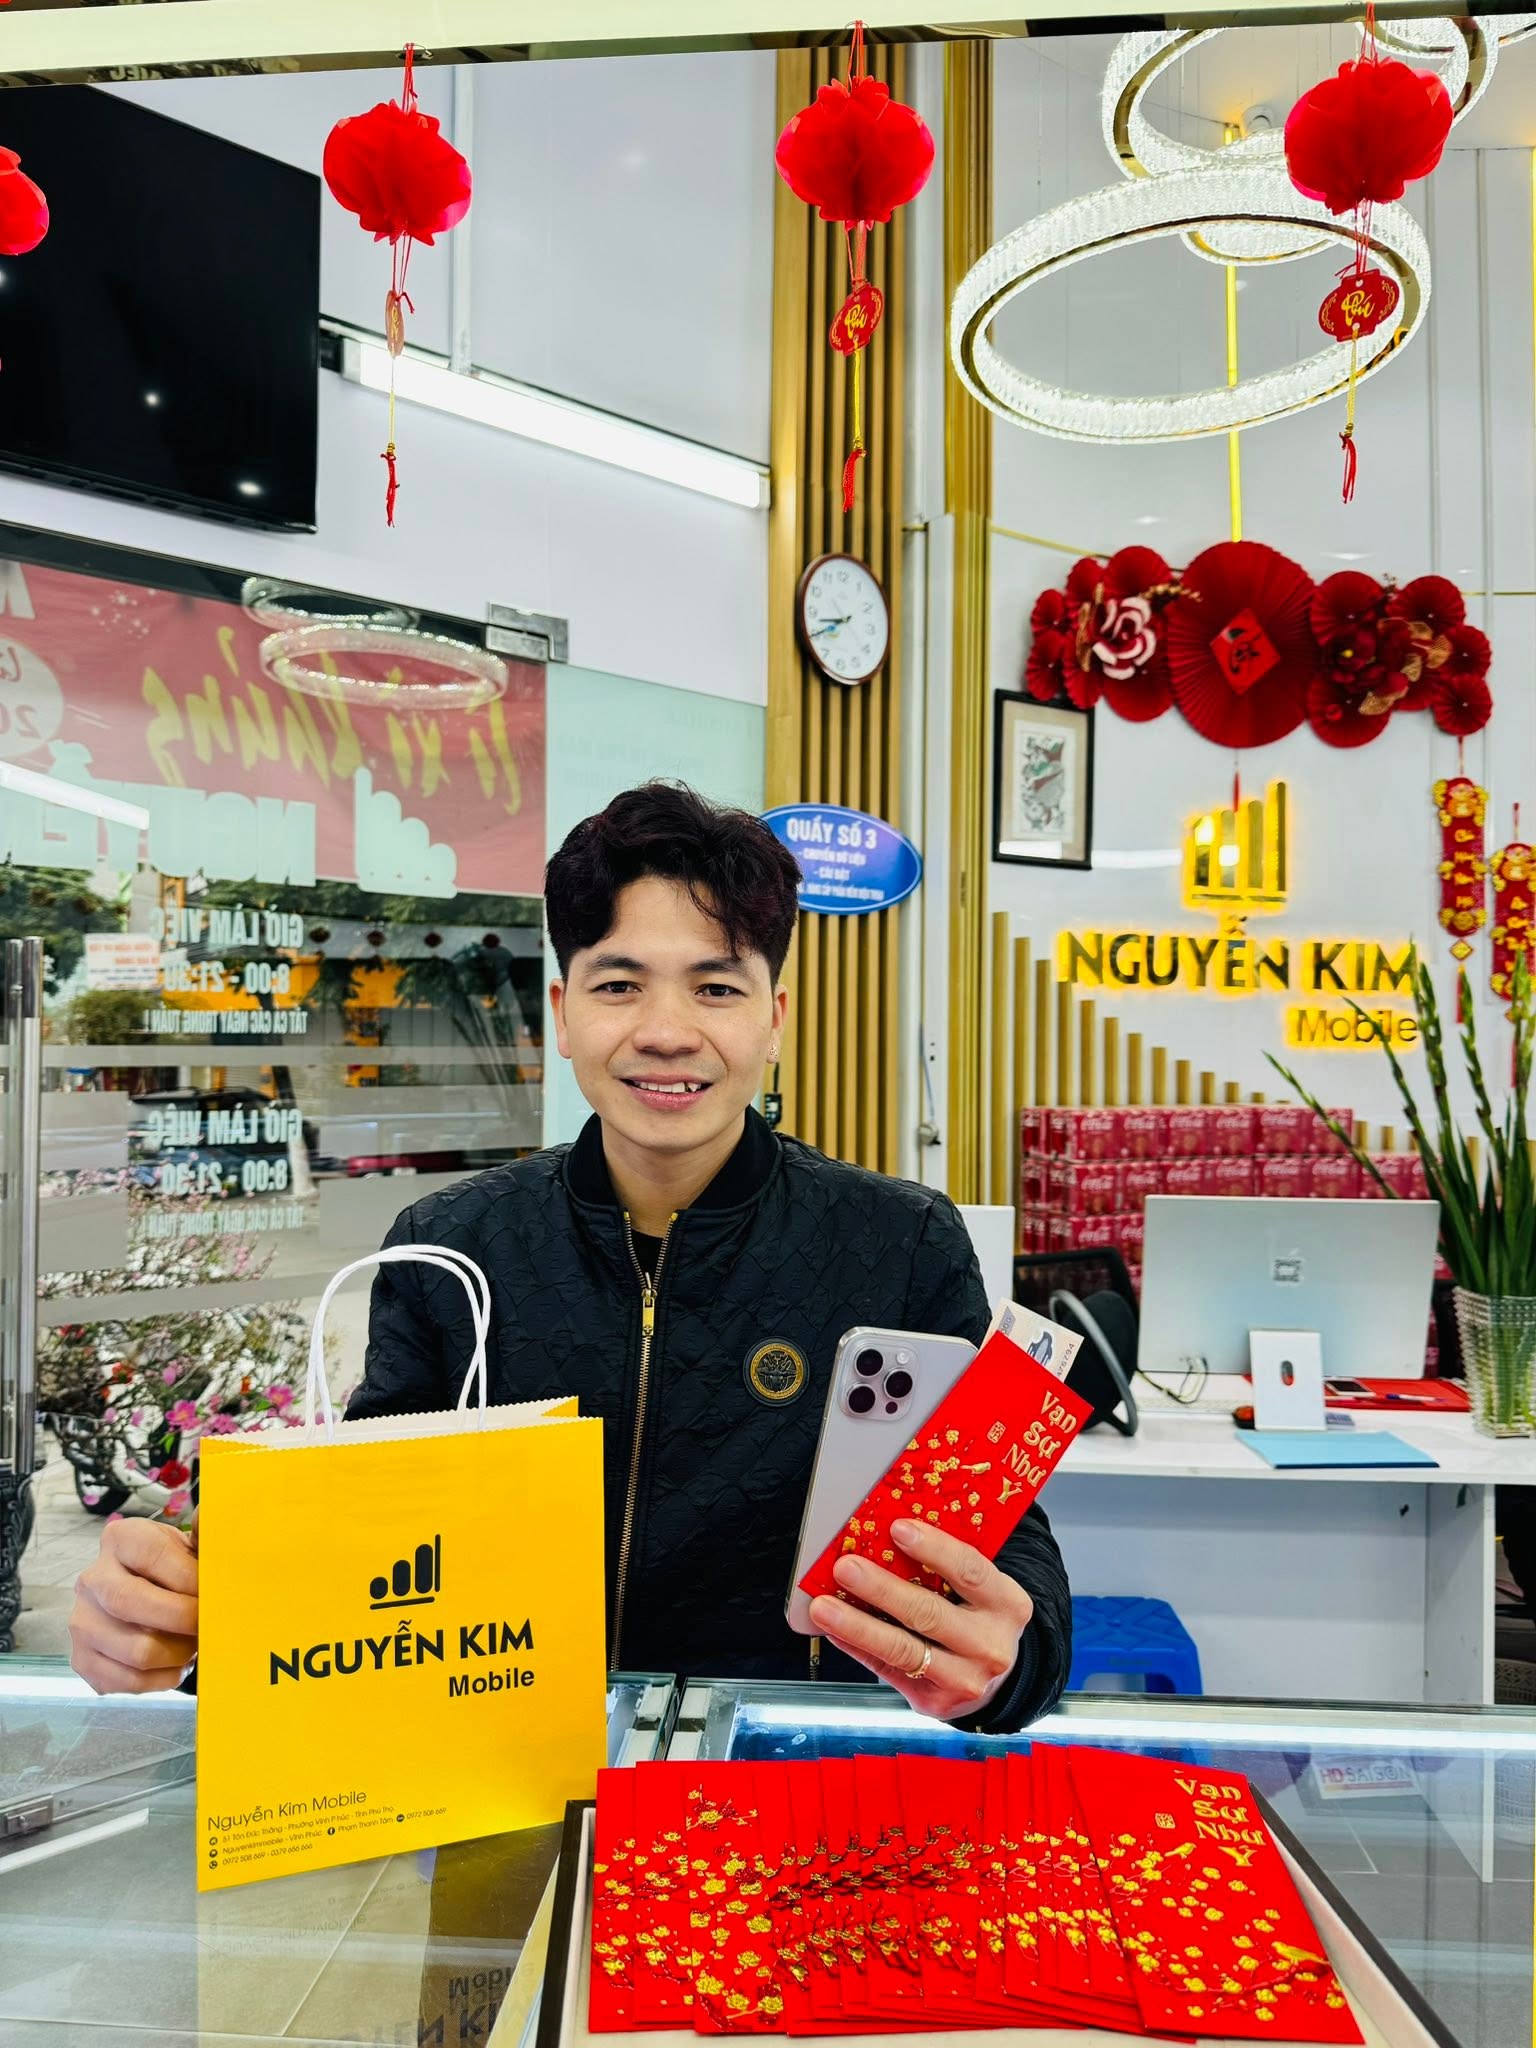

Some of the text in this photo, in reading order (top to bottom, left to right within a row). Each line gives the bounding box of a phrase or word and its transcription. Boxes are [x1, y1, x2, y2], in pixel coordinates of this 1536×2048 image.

[865, 829, 877, 849] 3
[1066, 914, 1414, 991] NGUYỄN KIM
[1297, 1009, 1418, 1043] Mobile
[1040, 1390, 1078, 1434] Vạn
[1023, 1421, 1061, 1459] Sự
[1001, 1443, 1047, 1488] Như
[997, 1476, 1023, 1504] Ý
[270, 1618, 534, 1685] NGUYỄN KIM
[449, 1668, 535, 1697] Mobile
[1174, 1778, 1242, 1800] Vạn
[207, 1790, 367, 1832] Nguyễn Kim Mobile
[1192, 1800, 1249, 1824] Sự
[1194, 1820, 1266, 1846] Như
[1217, 1845, 1258, 1867] Ý
